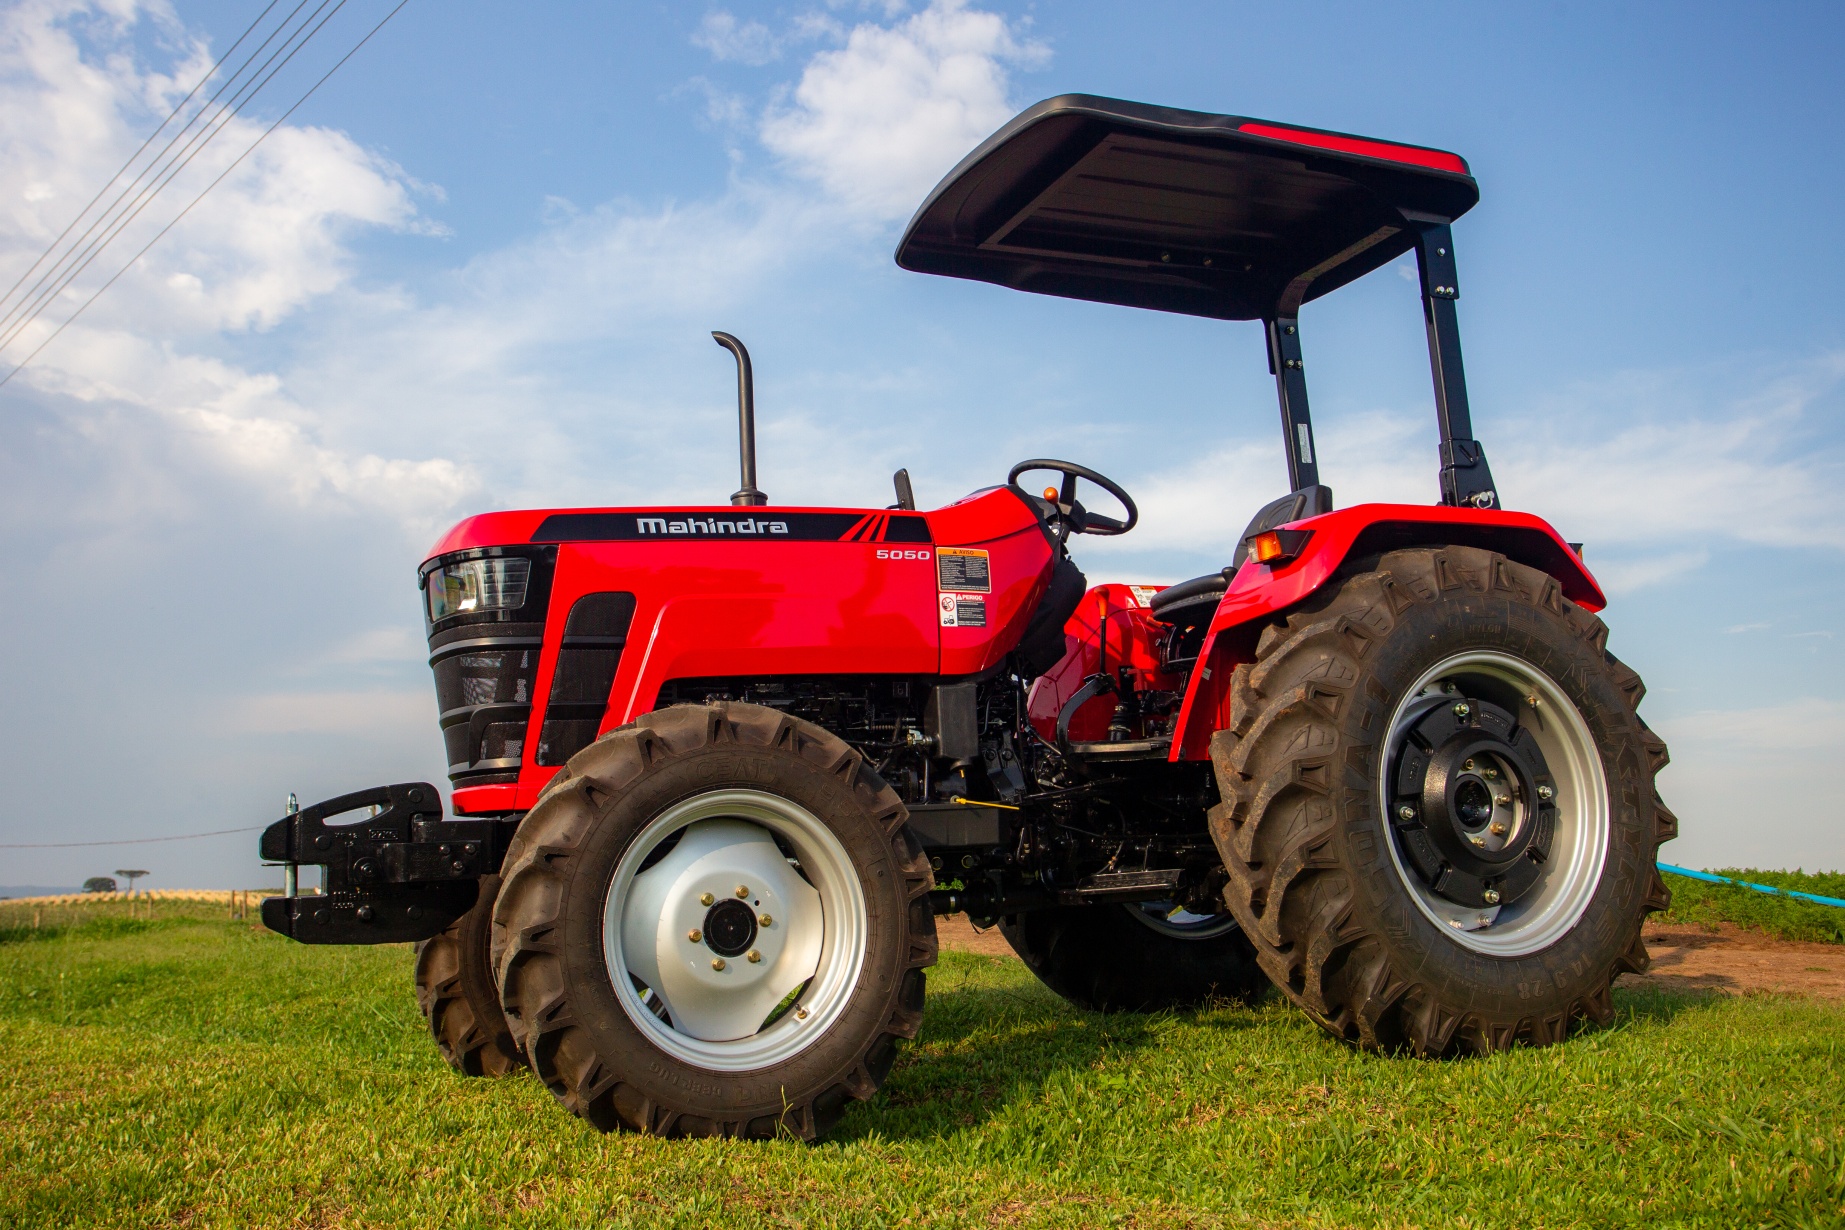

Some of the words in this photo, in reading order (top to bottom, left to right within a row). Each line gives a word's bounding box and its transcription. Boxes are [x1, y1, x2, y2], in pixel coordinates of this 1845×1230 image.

[636, 517, 789, 534] Mahindra
[876, 549, 930, 560] 5050
[696, 757, 767, 782] CEAT
[1516, 951, 1592, 1000] 14.9-28
